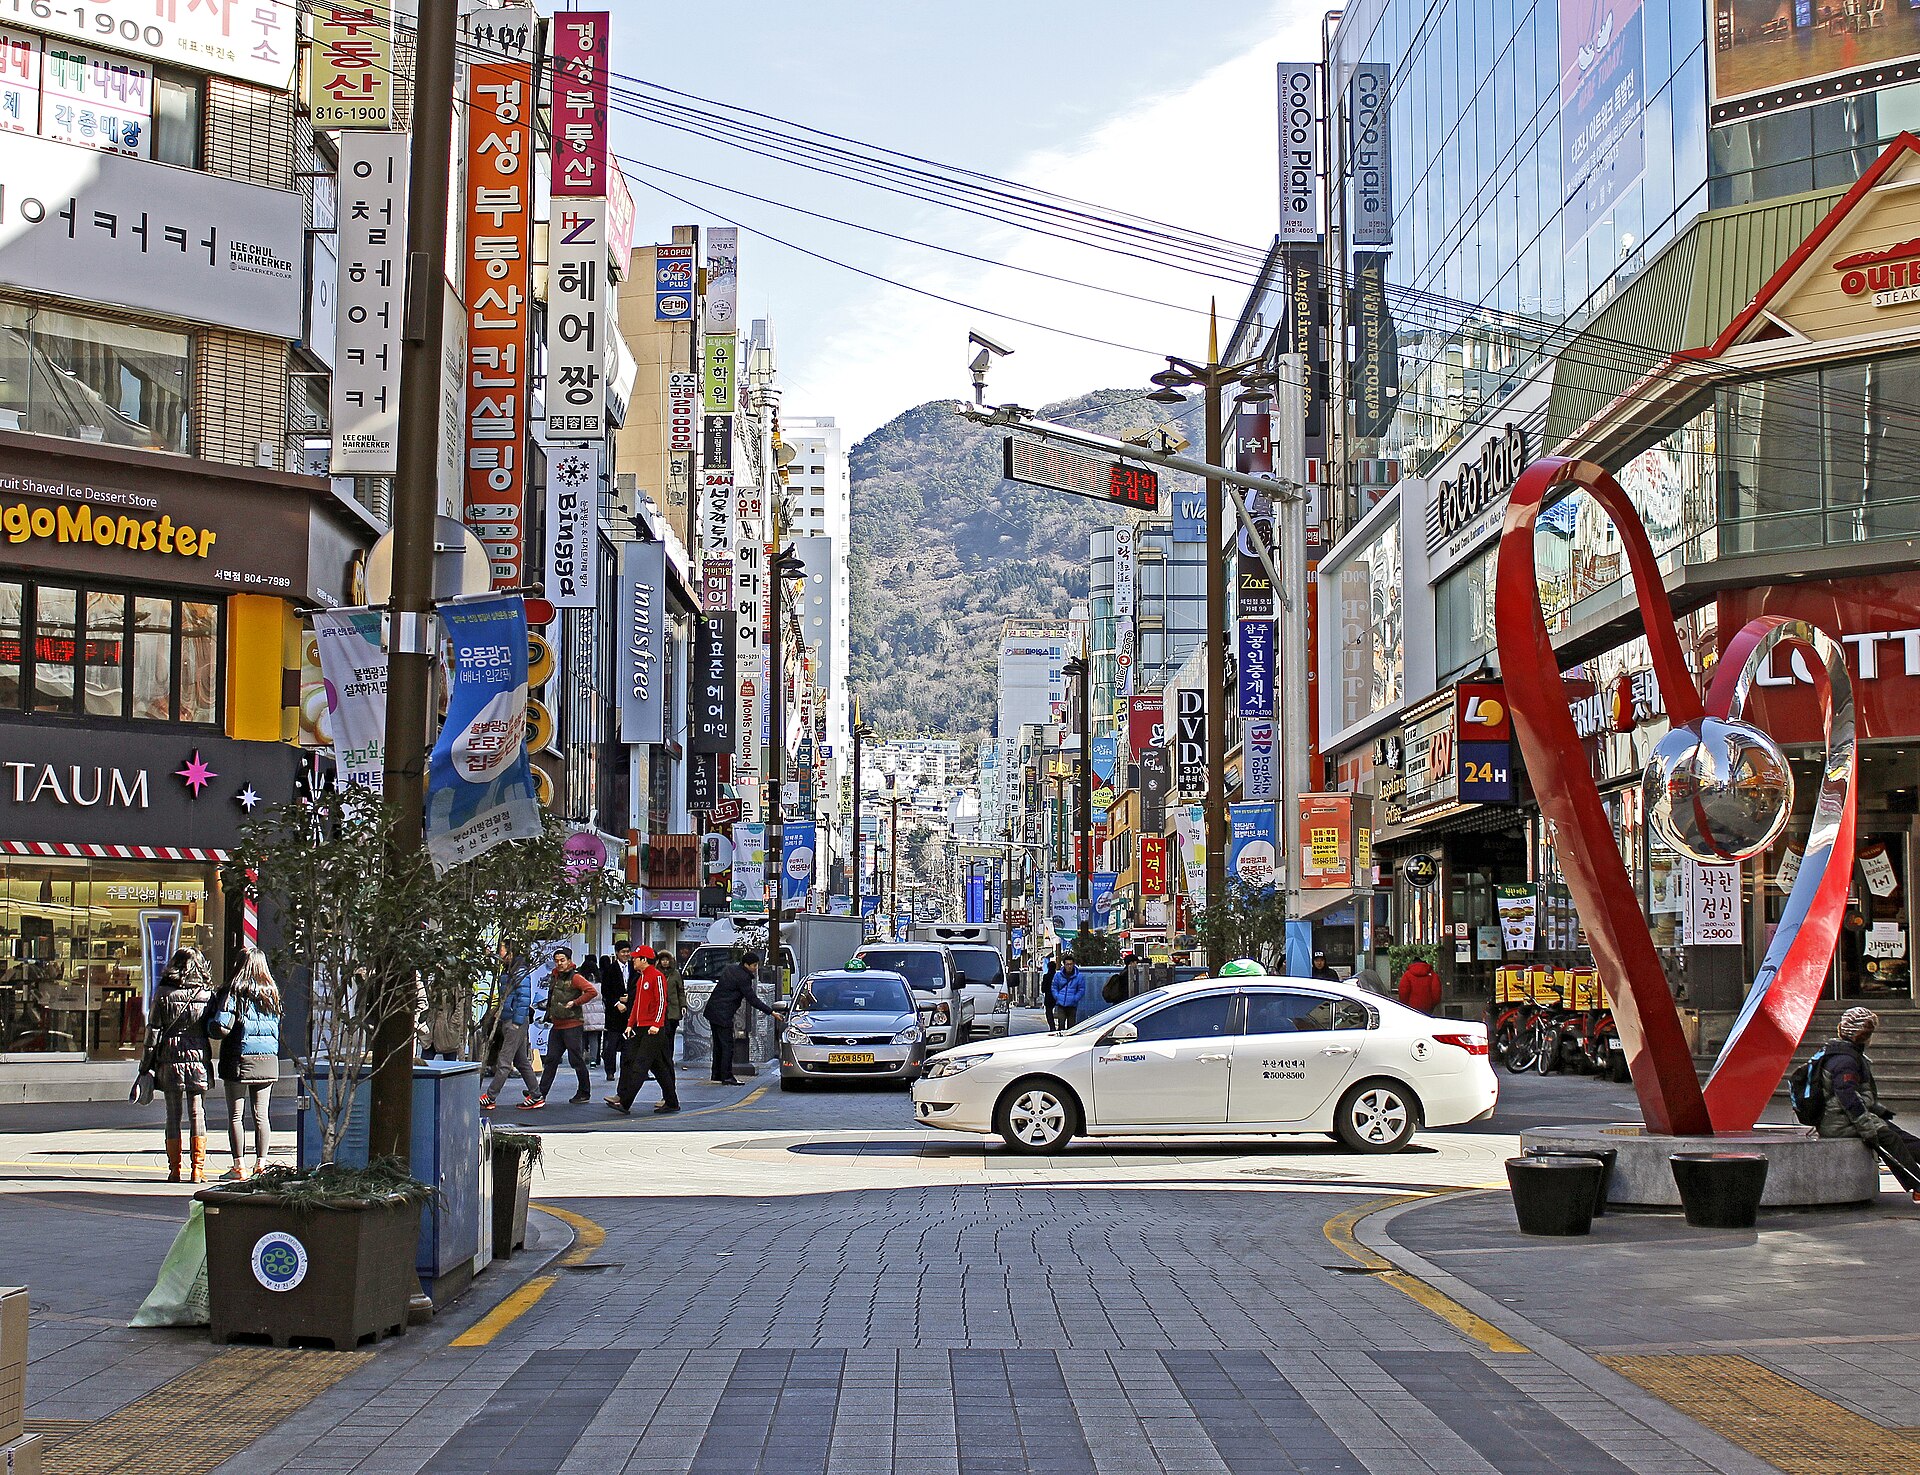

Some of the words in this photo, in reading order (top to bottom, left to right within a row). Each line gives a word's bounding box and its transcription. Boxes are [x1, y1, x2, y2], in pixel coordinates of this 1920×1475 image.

[322, 8, 382, 102] 부동산
[315, 106, 386, 121] 816-1900
[565, 21, 596, 187] 경성부동산
[1289, 72, 1312, 144] CoCo
[54, 104, 141, 148] 각종매장
[1290, 150, 1313, 213] Plate
[474, 80, 523, 330] 경성부동산
[0, 182, 218, 267] 어커커
[230, 240, 249, 253] LEE
[230, 251, 292, 271] HAIRKERKER
[661, 300, 687, 310] 담배
[1875, 287, 1919, 305] STEAK
[557, 260, 600, 405] 헤어짱
[712, 347, 729, 404] 유학원
[470, 343, 518, 491] 컨설팅
[551, 416, 598, 429] 美容室
[0, 479, 19, 491] ruit
[22, 479, 63, 496] Shaved
[66, 484, 82, 499] Ice
[85, 487, 126, 504] Dessert
[128, 493, 157, 508] Store
[0, 502, 217, 559] goMonster
[496, 546, 512, 556] 대
[214, 569, 241, 582] 서면점
[244, 573, 290, 587] 804-7989
[496, 565, 511, 576] 매
[739, 546, 760, 648] 헤라헤어
[629, 582, 657, 701] innisfree
[1244, 623, 1269, 635] 삼주
[353, 665, 389, 682] 불법광고
[1245, 635, 1267, 709] 공인중개사
[1179, 691, 1204, 765] DVD
[1251, 723, 1273, 757] BR
[343, 749, 368, 769] 걷고
[741, 729, 752, 760] TOUCH
[3, 761, 149, 808] TAUM
[346, 771, 385, 791] 서면특
[1251, 757, 1262, 796] robbins
[1262, 756, 1273, 794] baskin
[689, 801, 711, 809] 1972
[1145, 842, 1163, 891] 사격장
[1700, 868, 1734, 895] 착한
[1871, 875, 1891, 889] 1+1
[1700, 897, 1733, 920] 점심
[1702, 929, 1734, 940] 2,900
[852, 1054, 871, 1062] 8517
